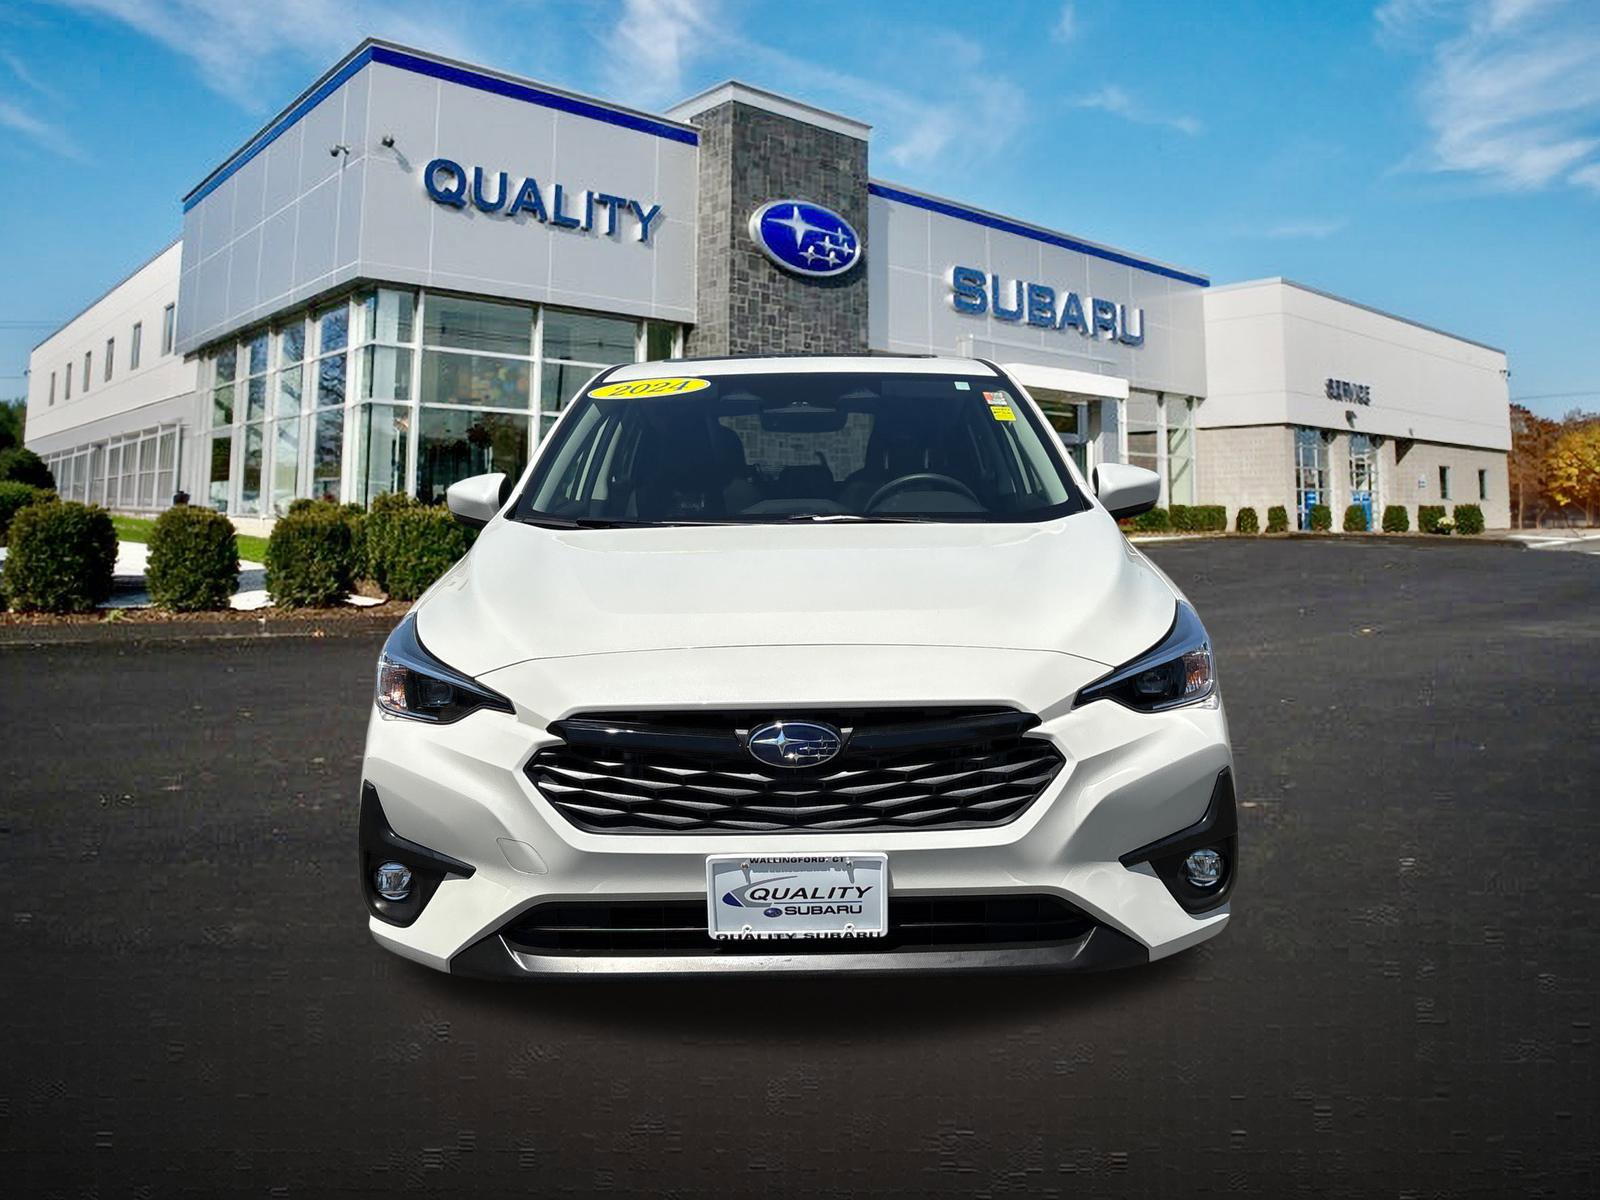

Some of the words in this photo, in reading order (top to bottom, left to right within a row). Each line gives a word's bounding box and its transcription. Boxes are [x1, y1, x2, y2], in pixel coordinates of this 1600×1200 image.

[424, 158, 661, 242] QUALITY
[951, 265, 1145, 346] SUBARU
[608, 380, 691, 396] 2024
[749, 886, 873, 901] QUALITY
[785, 905, 862, 915] SUBARU
[716, 932, 797, 940] QUALITY
[804, 930, 880, 939] SUBARU
